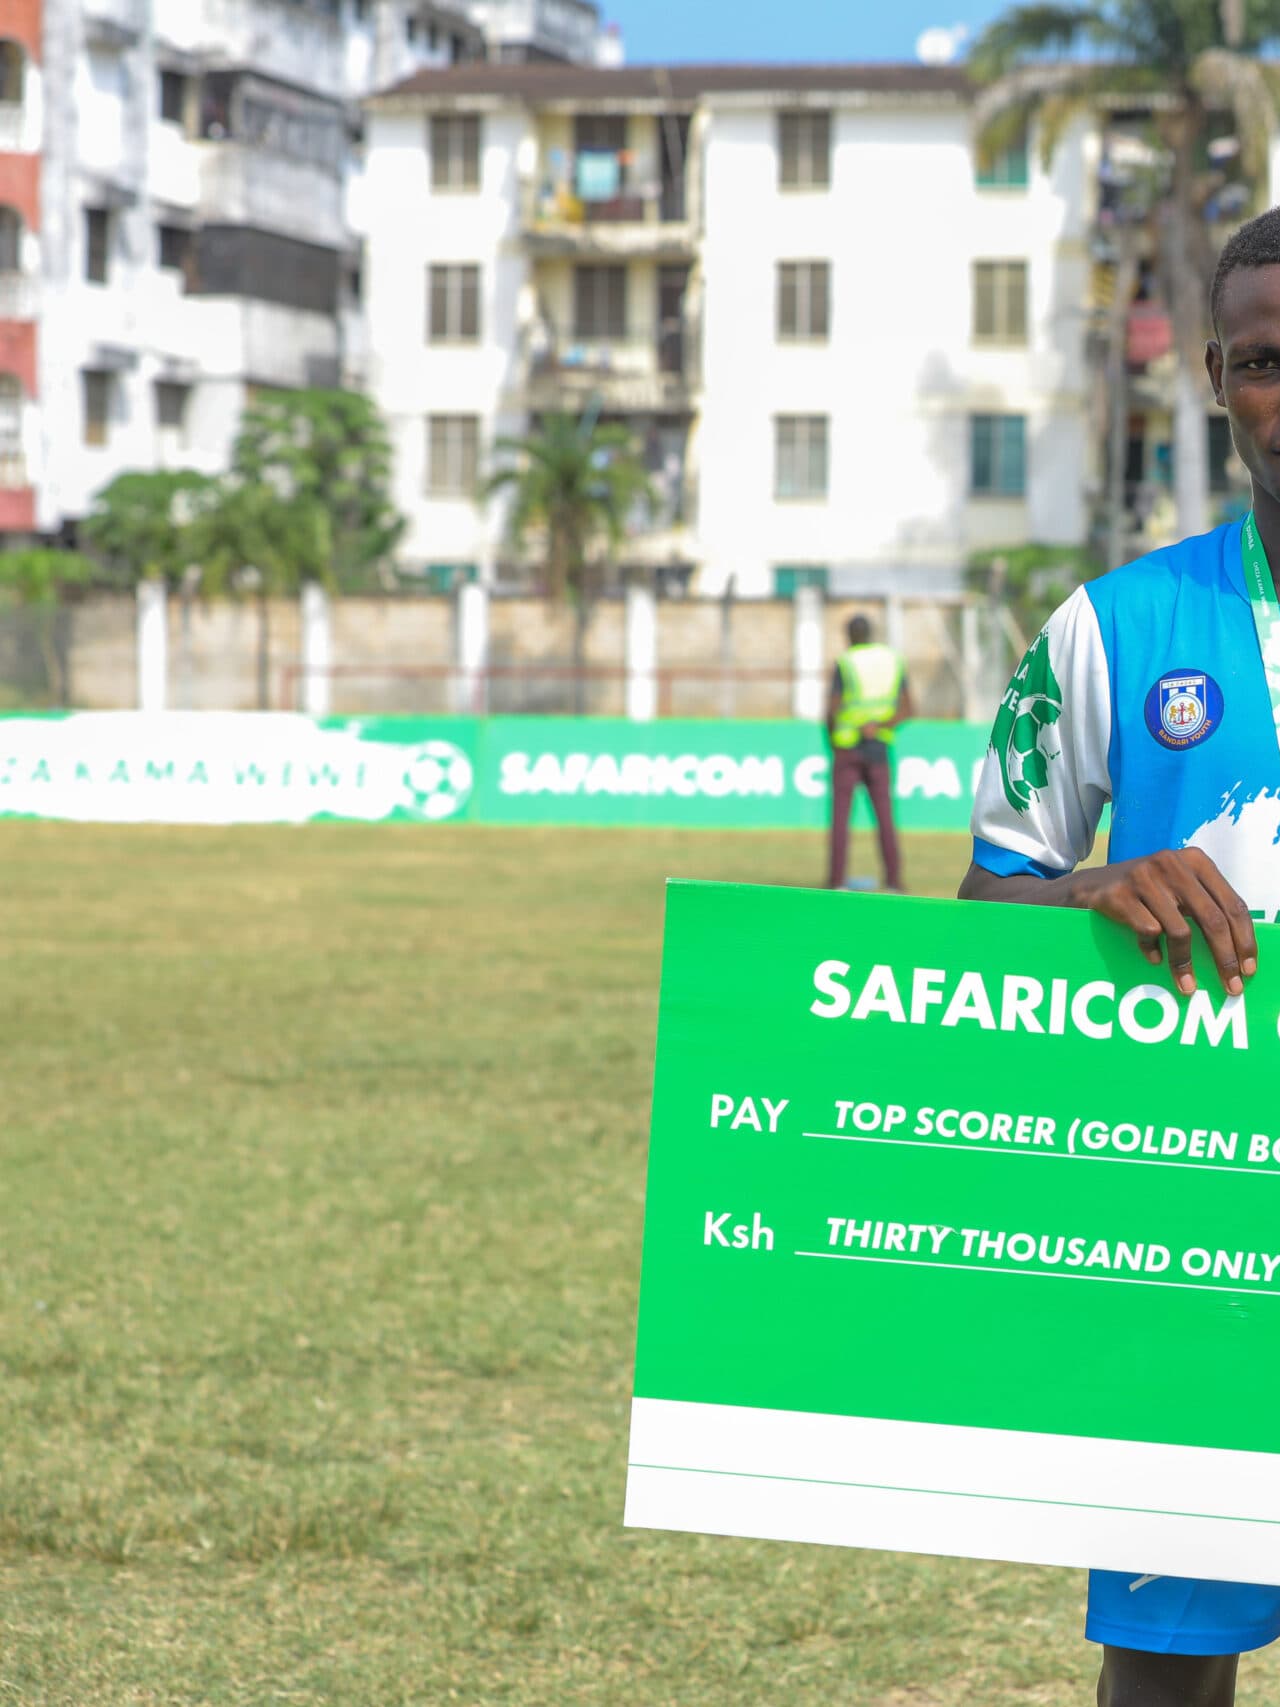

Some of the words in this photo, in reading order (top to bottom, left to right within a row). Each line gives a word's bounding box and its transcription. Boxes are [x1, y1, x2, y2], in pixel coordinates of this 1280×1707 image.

[1158, 729, 1189, 745] BANDARI
[1191, 719, 1213, 741] YOUTH
[499, 752, 784, 797] SAFARICOM
[810, 960, 1249, 1049] SAFARICOM
[711, 1094, 788, 1132] PAY
[836, 1101, 906, 1132] TOP
[914, 1108, 1055, 1145] SCORER
[1067, 1119, 1238, 1159] (GOLDEN
[704, 1212, 774, 1250] Ksh
[828, 1218, 953, 1253] THIRTY
[961, 1229, 1170, 1272] THOUSAND
